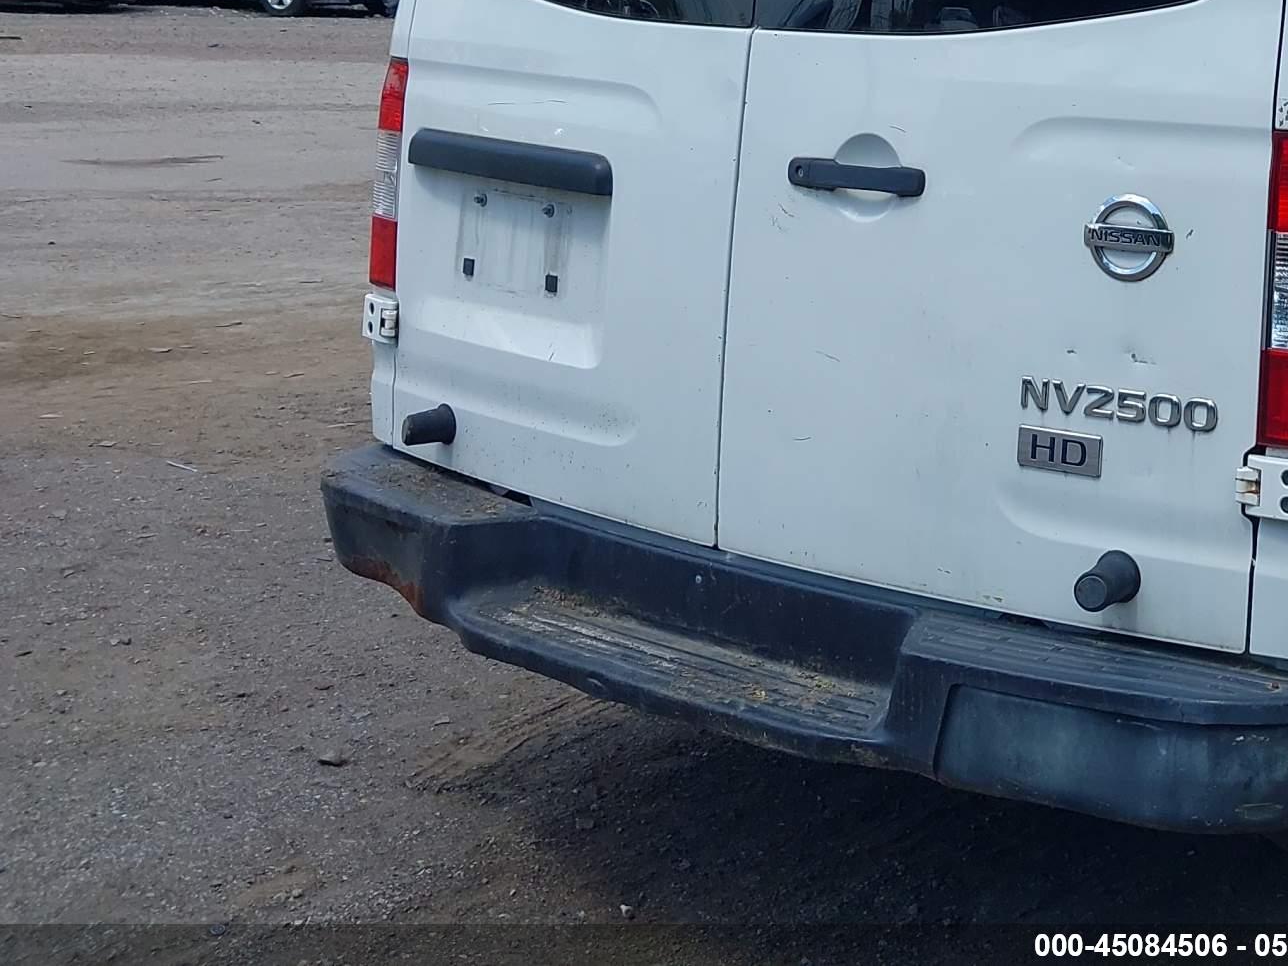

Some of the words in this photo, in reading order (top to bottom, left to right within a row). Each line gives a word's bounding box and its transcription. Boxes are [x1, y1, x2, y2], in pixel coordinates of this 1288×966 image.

[1089, 226, 1161, 247] NISSAN
[1020, 375, 1219, 433] NV2500
[1030, 433, 1087, 467] HD
